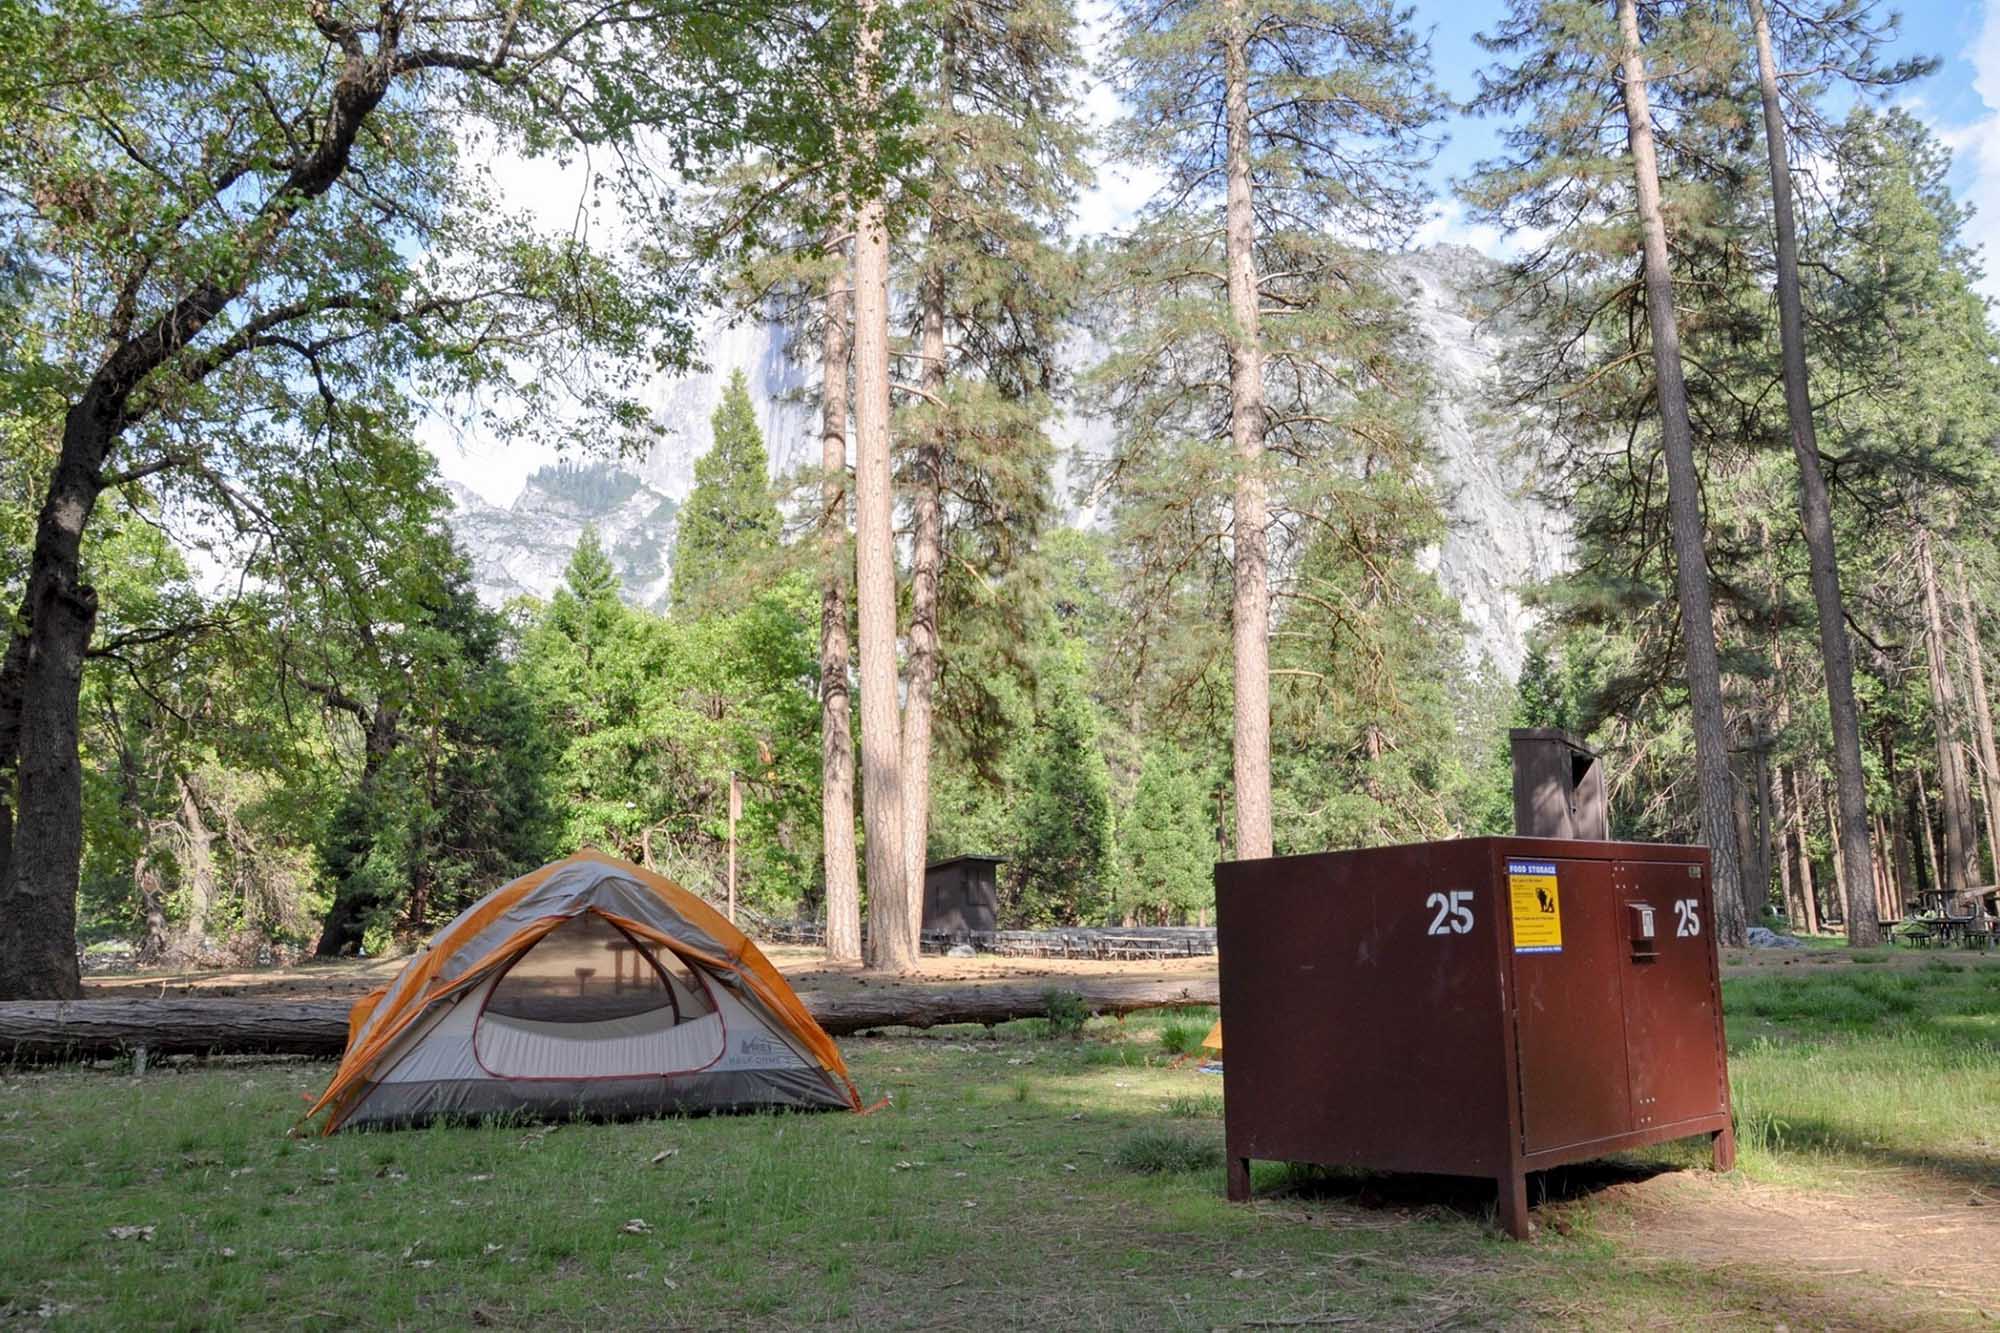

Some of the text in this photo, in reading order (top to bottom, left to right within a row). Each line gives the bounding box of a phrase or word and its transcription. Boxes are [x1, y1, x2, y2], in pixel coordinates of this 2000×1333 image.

[1509, 865, 1556, 874] FOOD STORAGE
[1426, 890, 1474, 935] 25
[1674, 898, 1700, 937] 25
